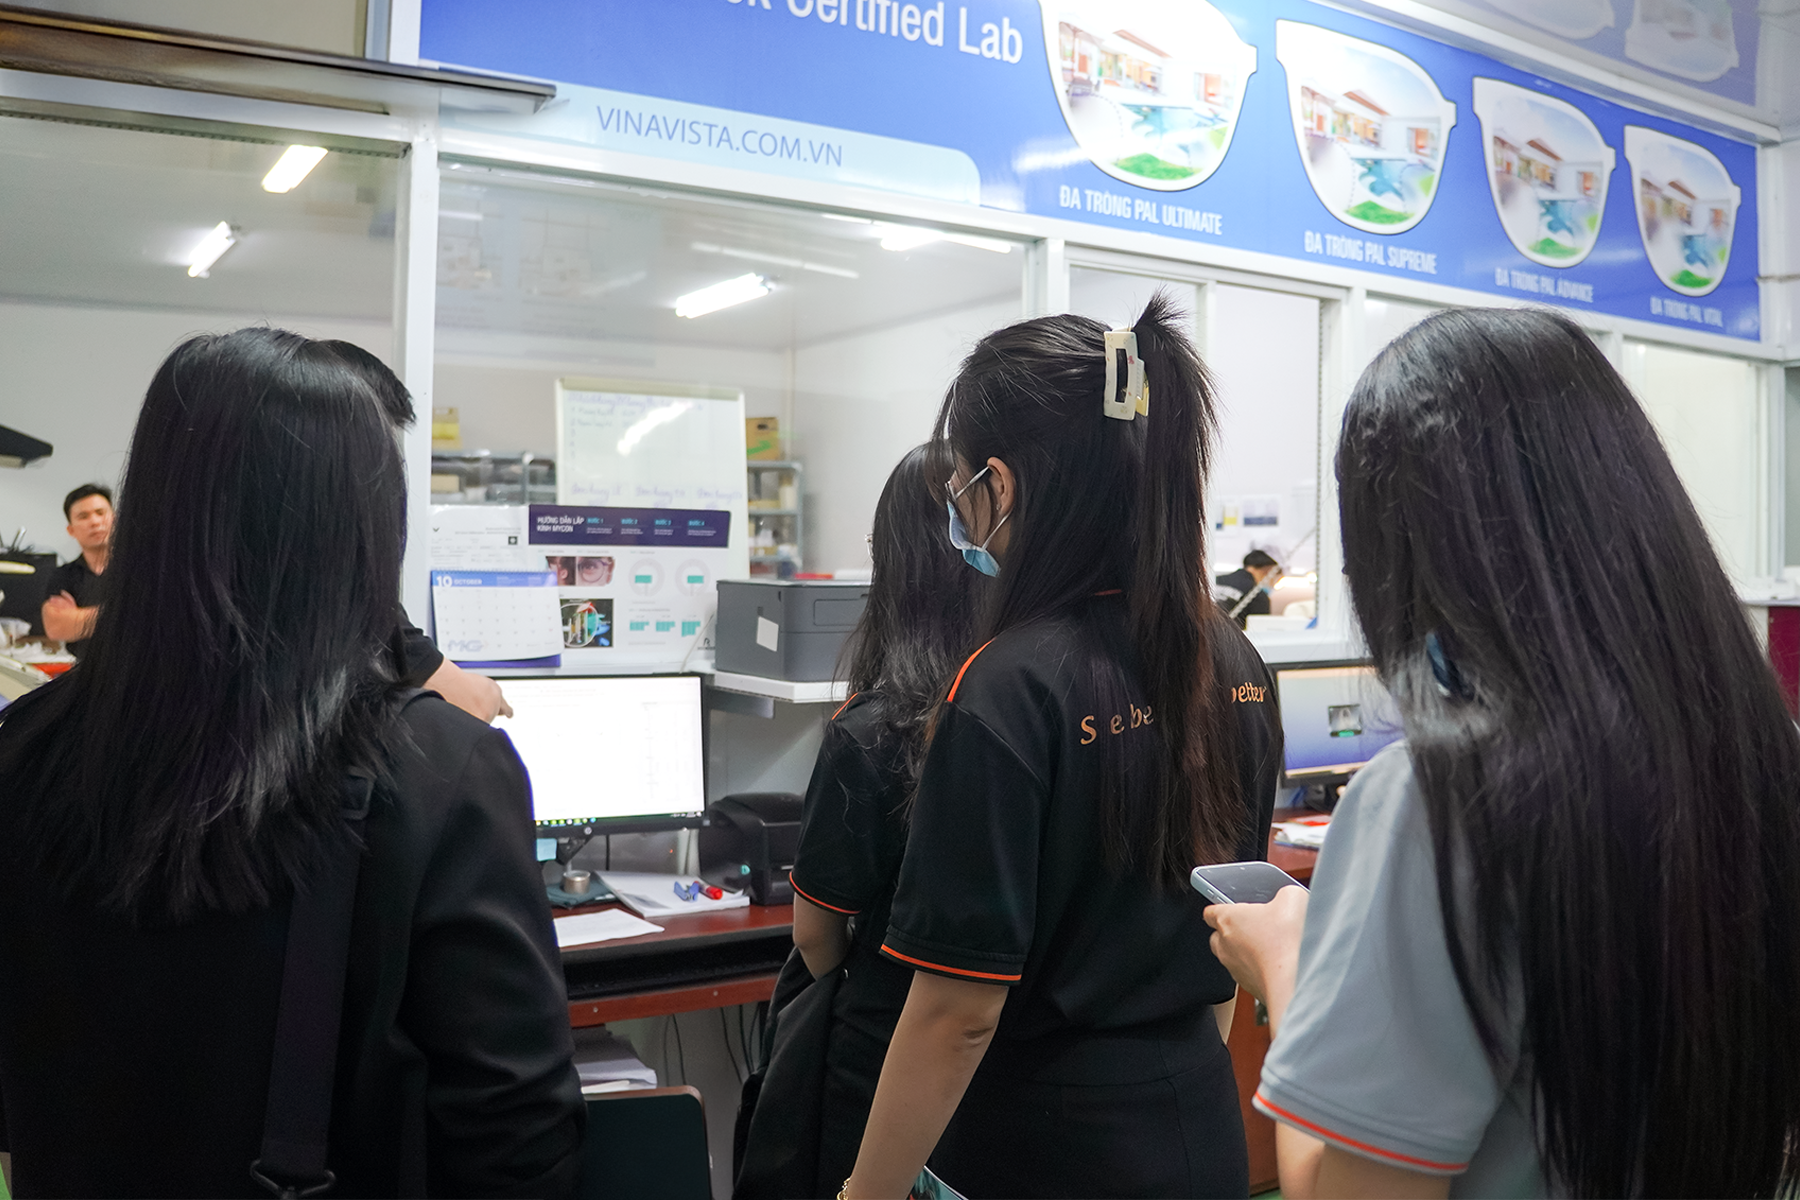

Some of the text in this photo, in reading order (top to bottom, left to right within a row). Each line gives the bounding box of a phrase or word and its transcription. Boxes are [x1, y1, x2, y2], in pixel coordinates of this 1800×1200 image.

[958, 6, 1023, 64] Lab
[596, 105, 843, 167] VINAVISTA.COM.VN
[1059, 185, 1223, 235] ĐA TRÒNG PAL ULTIMATE
[1304, 230, 1323, 254] ĐA
[1364, 241, 1387, 266] PAL
[1387, 245, 1438, 275] SUPREME
[436, 575, 483, 588] 10 OCTOBER
